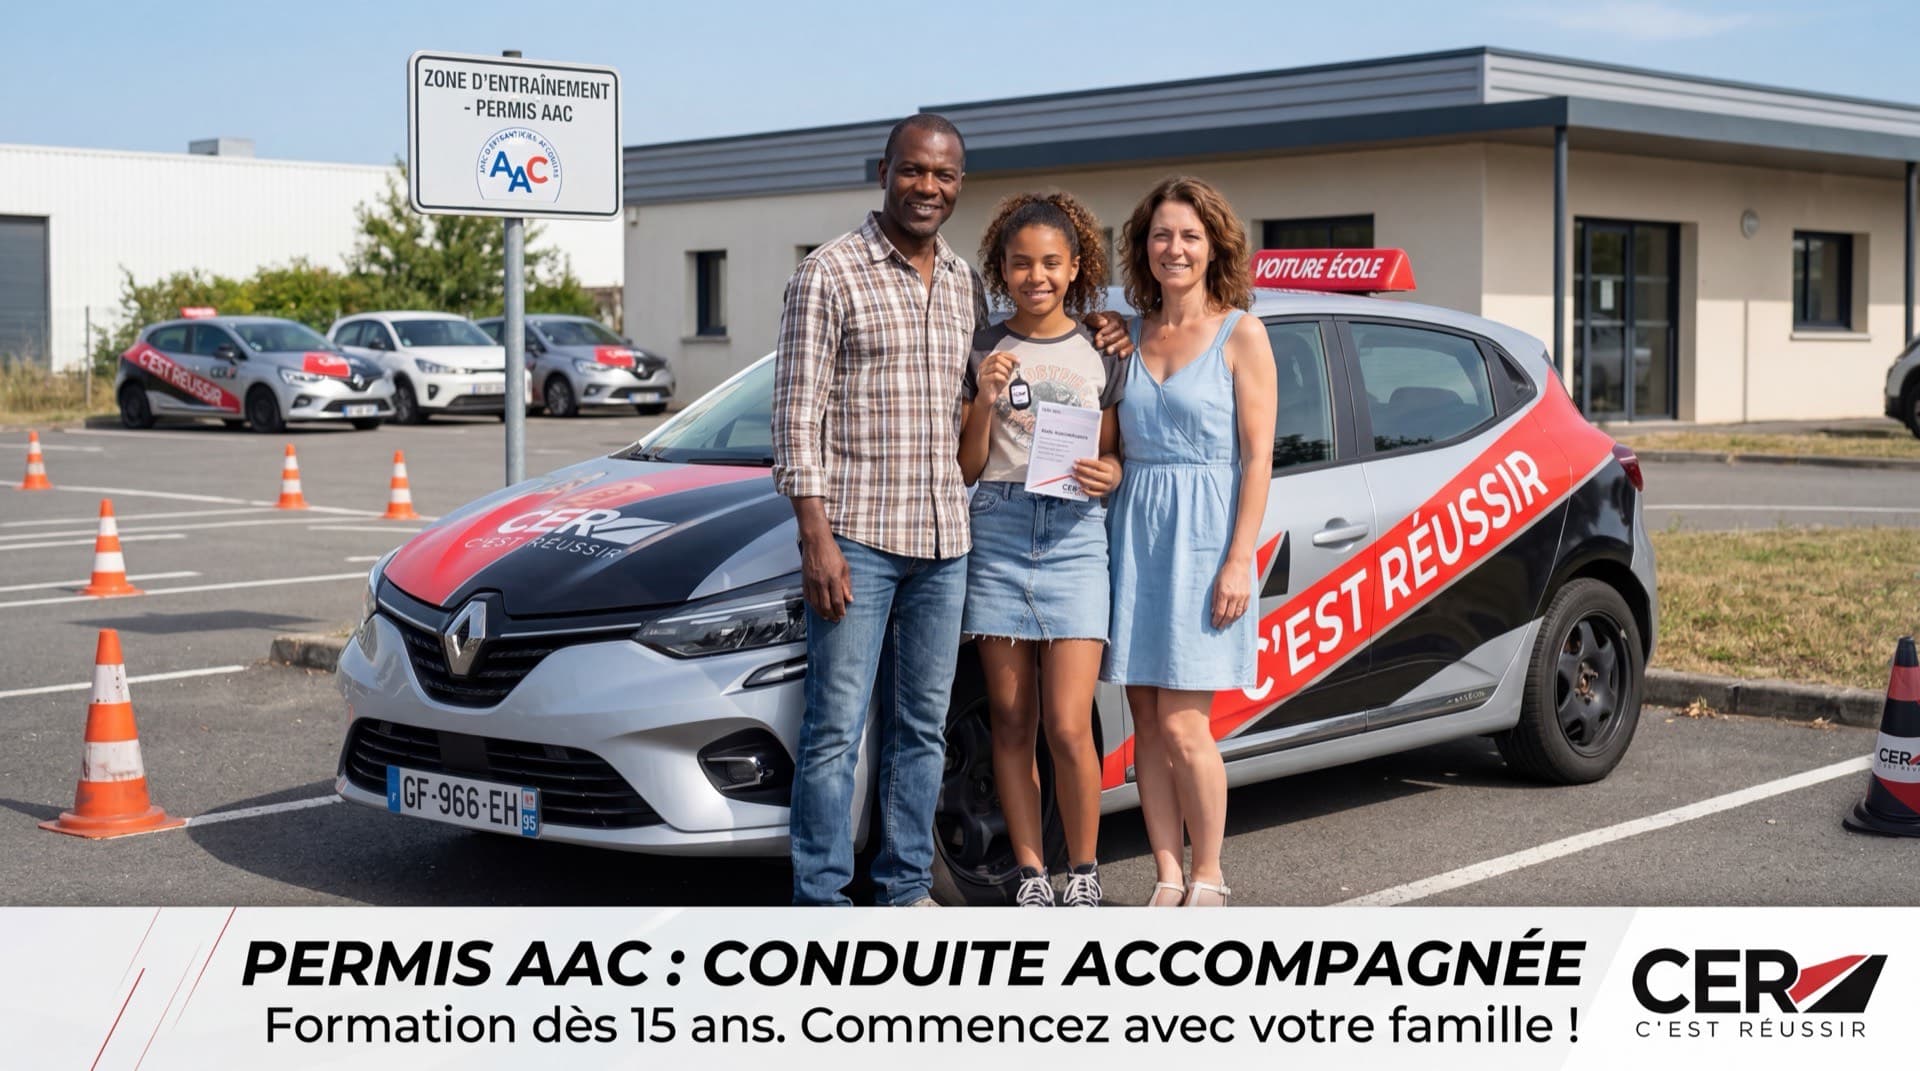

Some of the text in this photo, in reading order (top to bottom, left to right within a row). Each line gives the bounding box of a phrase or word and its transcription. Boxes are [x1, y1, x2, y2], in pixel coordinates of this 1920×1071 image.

[424, 69, 610, 100] ZONE D'ENTRAÎNEMENT
[476, 99, 537, 120] PERMIS
[541, 104, 573, 122] AAC
[489, 150, 549, 193] AAC
[1255, 252, 1384, 279] VOITURE ÉCOLE
[497, 508, 621, 536] CER
[1379, 450, 1549, 611] RÉUSSIR
[464, 537, 523, 548] C'EST
[1879, 747, 1912, 766] CER
[404, 776, 518, 827] GF-966-EH
[523, 815, 536, 831] 95
